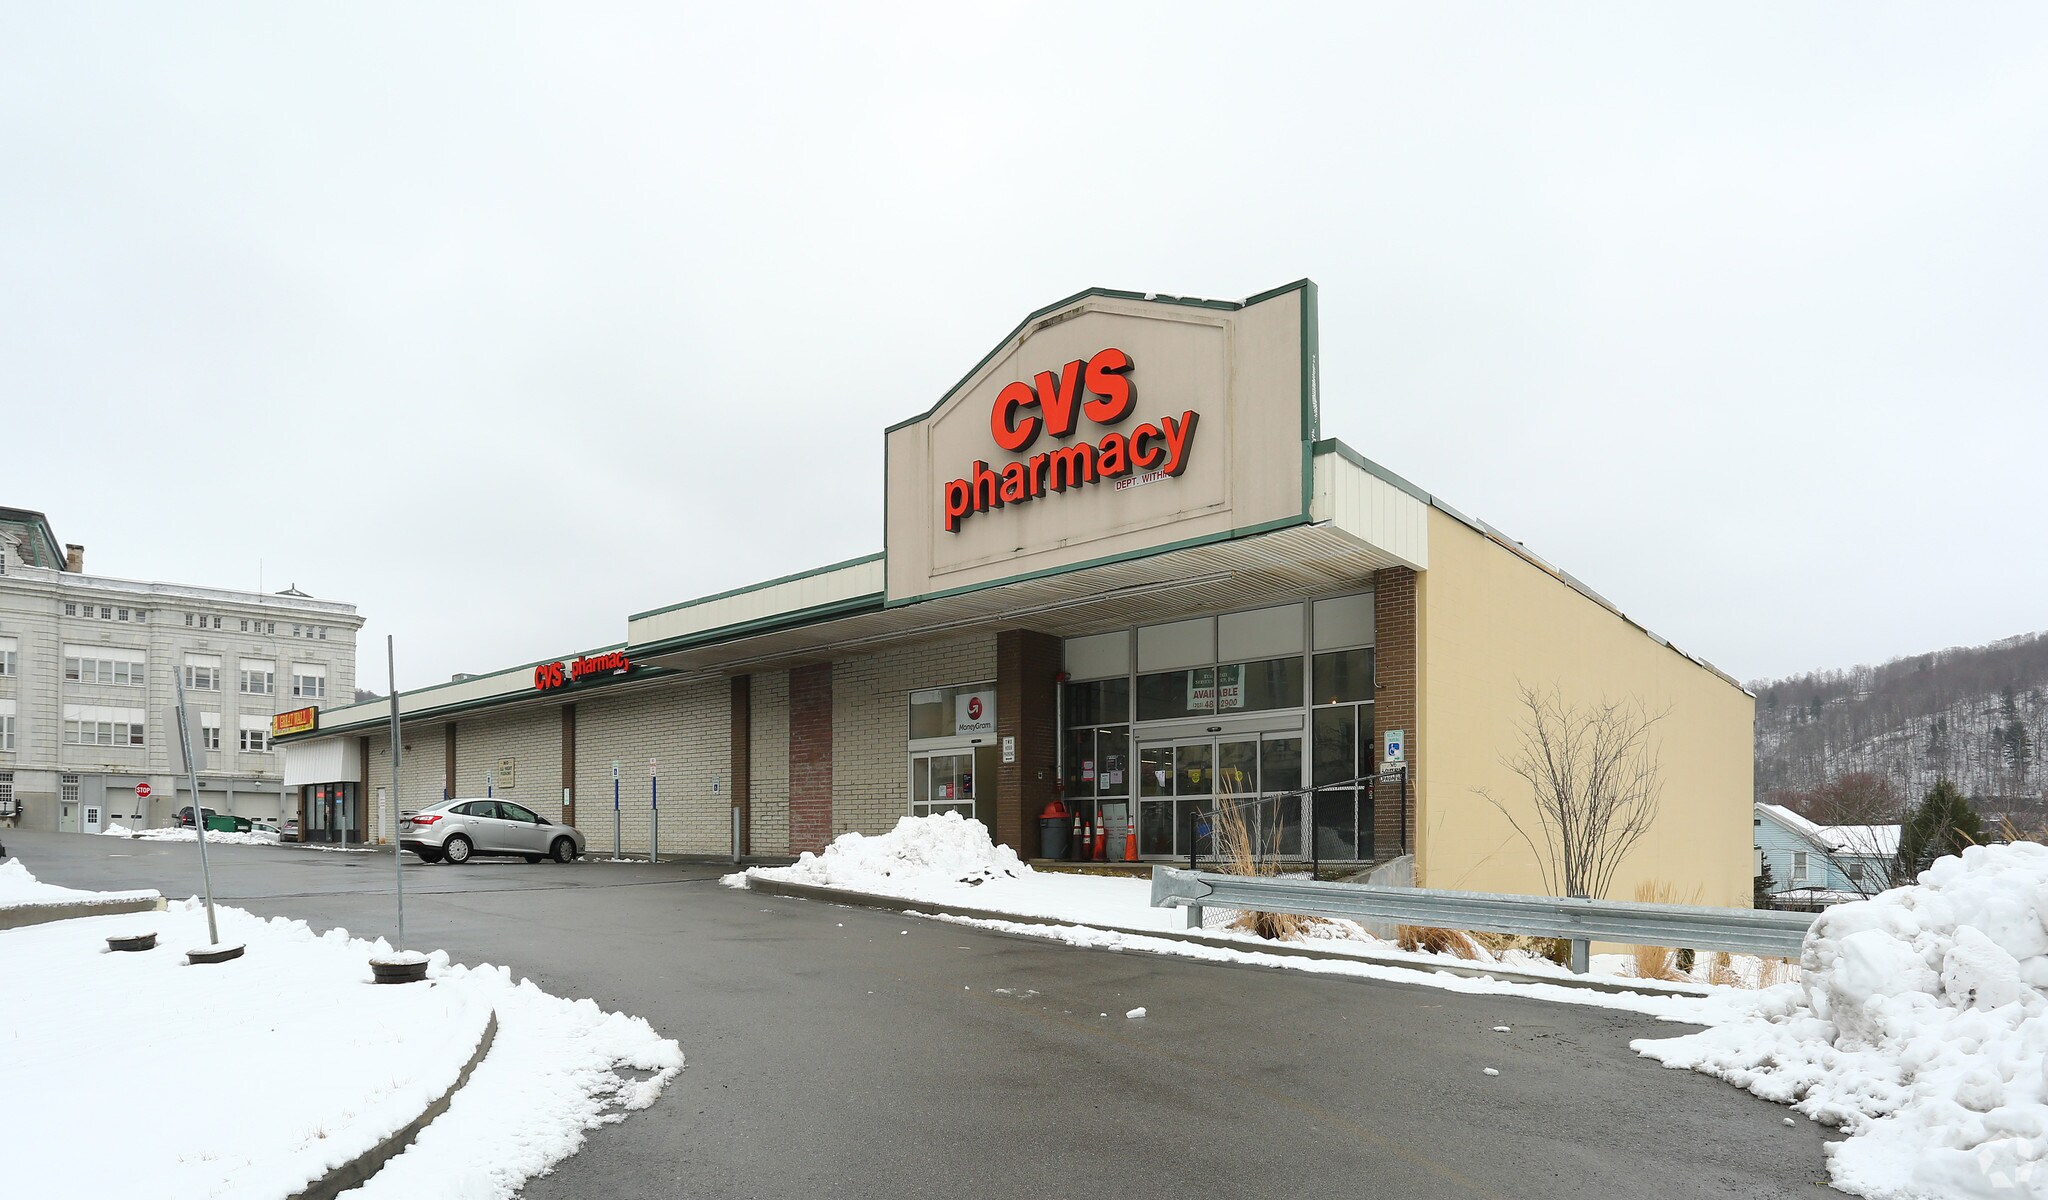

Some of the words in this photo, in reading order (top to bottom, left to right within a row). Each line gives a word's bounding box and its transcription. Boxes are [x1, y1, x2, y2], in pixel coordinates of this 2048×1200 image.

[990, 347, 1136, 452] CVS
[945, 410, 1199, 533] pharmacy
[1116, 477, 1139, 490] DEPT.
[535, 661, 562, 690] CVS
[958, 722, 991, 731] MoneyGram
[136, 786, 151, 794] STOP
